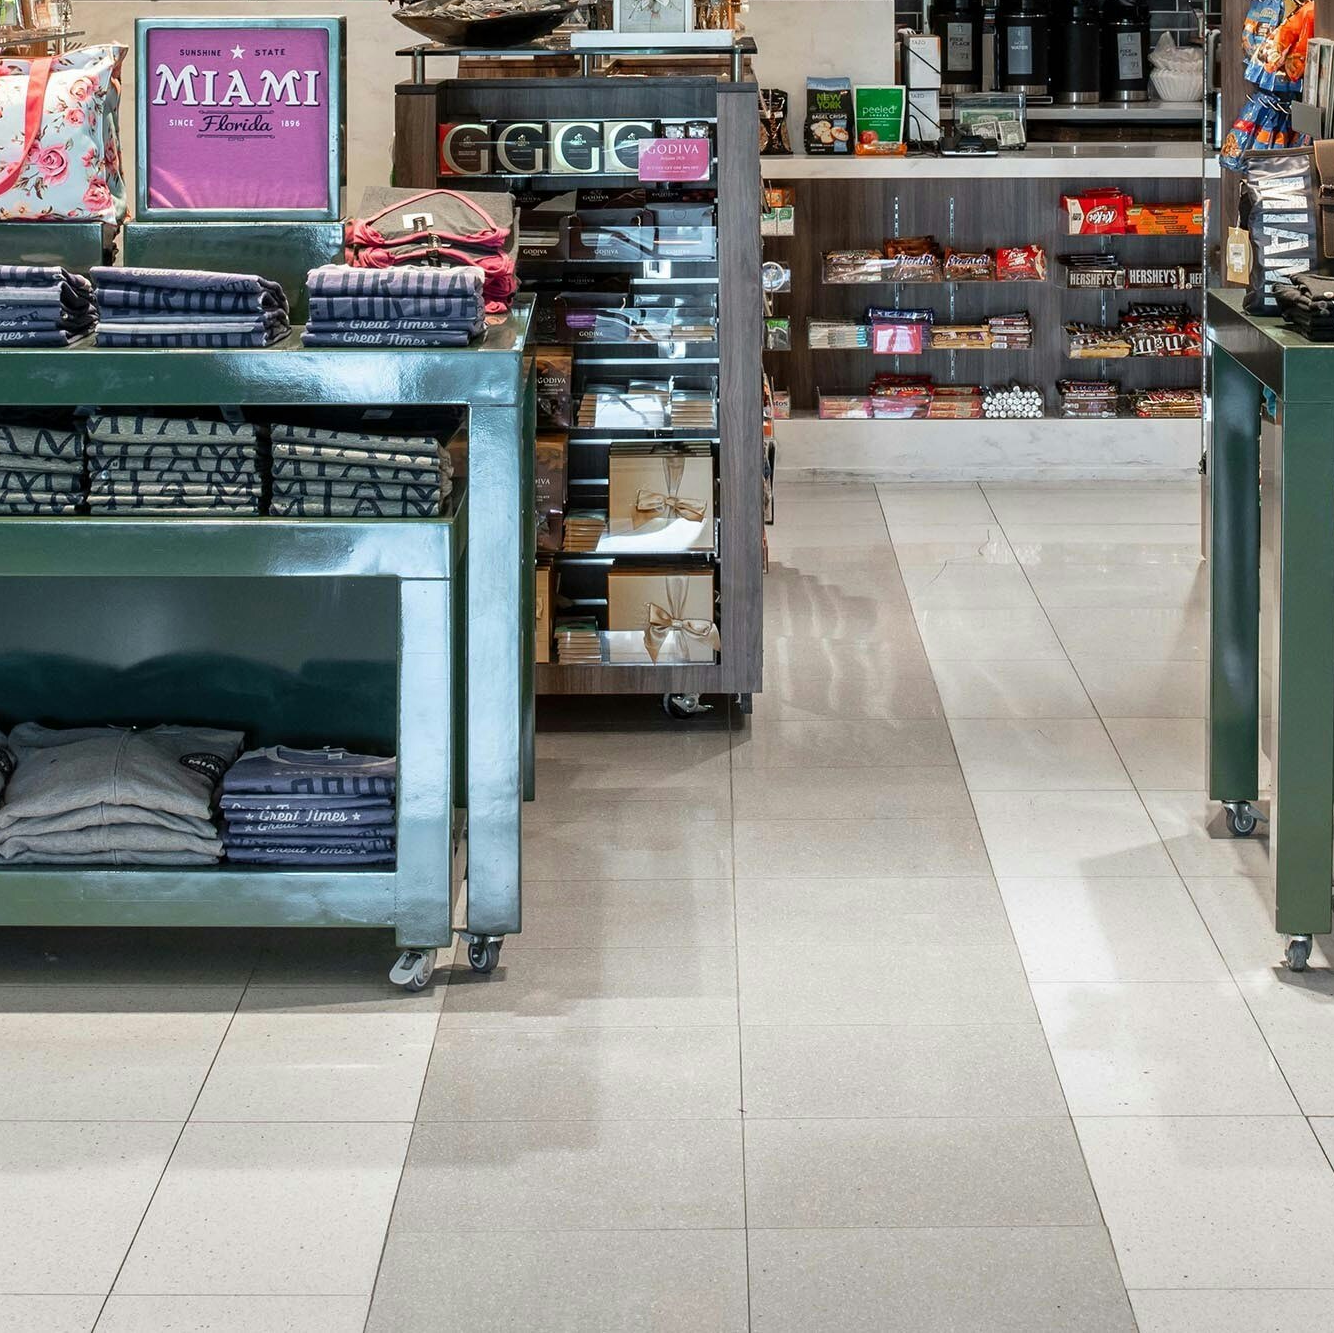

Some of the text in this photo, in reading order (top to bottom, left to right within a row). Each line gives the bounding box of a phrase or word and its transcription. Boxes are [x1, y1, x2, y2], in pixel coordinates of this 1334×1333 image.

[179, 49, 286, 57] SUNSHINE STATE
[152, 64, 321, 107] MIAMI
[817, 100, 841, 109] YORK
[863, 106, 895, 116] peeled
[169, 119, 194, 127] SINCE
[199, 114, 273, 132] Florida
[647, 144, 699, 154] GODIVA
[1070, 270, 1176, 285] HERSHEY'S HERSHEY'S
[343, 332, 427, 346] Great Times
[537, 377, 566, 385] GODIVA
[259, 810, 347, 822] Great Times
